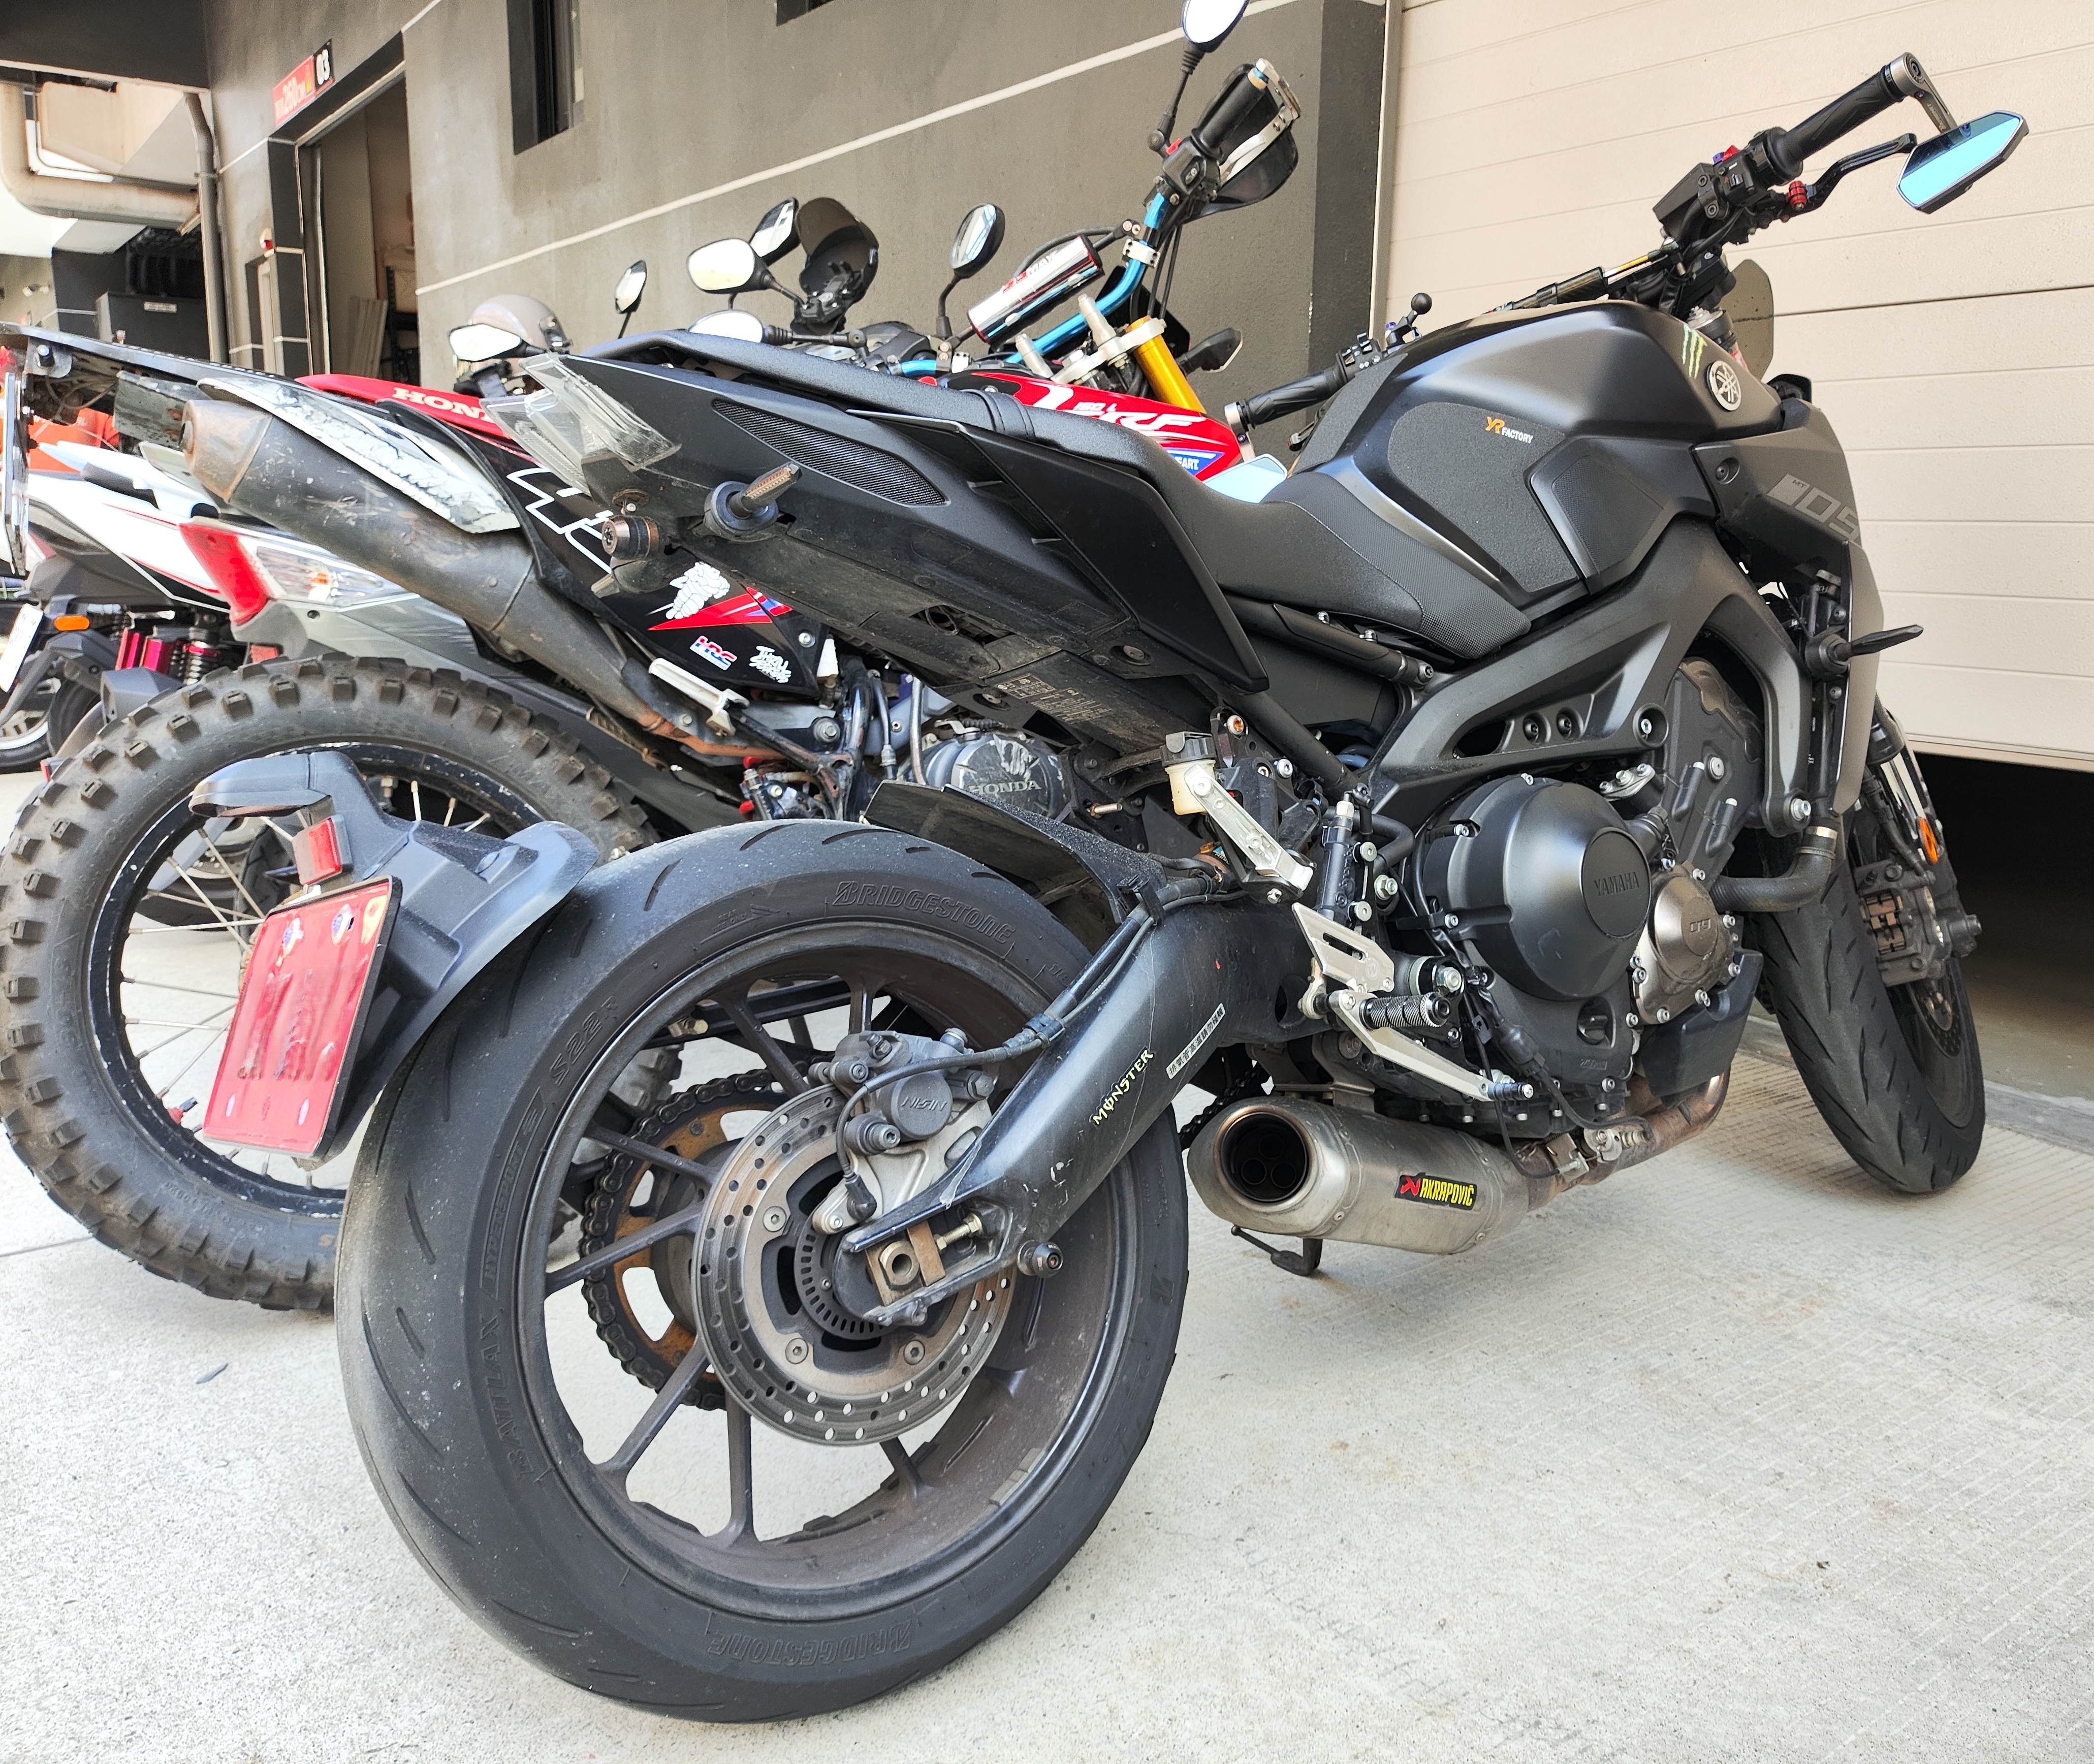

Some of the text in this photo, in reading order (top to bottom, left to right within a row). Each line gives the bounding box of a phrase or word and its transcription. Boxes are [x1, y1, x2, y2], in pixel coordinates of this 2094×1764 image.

[1501, 427, 1534, 444] FACTORY
[1792, 479, 1807, 488] MT
[694, 638, 736, 667] HRC
[968, 780, 1041, 795] HONDA
[1594, 871, 1640, 896] YAMAHA
[832, 880, 1016, 943] BRIDGESTONE
[550, 1011, 603, 1087] S22
[480, 1314, 535, 1478] BATTLAX
[708, 1622, 912, 1666] BRIDGESTONE
